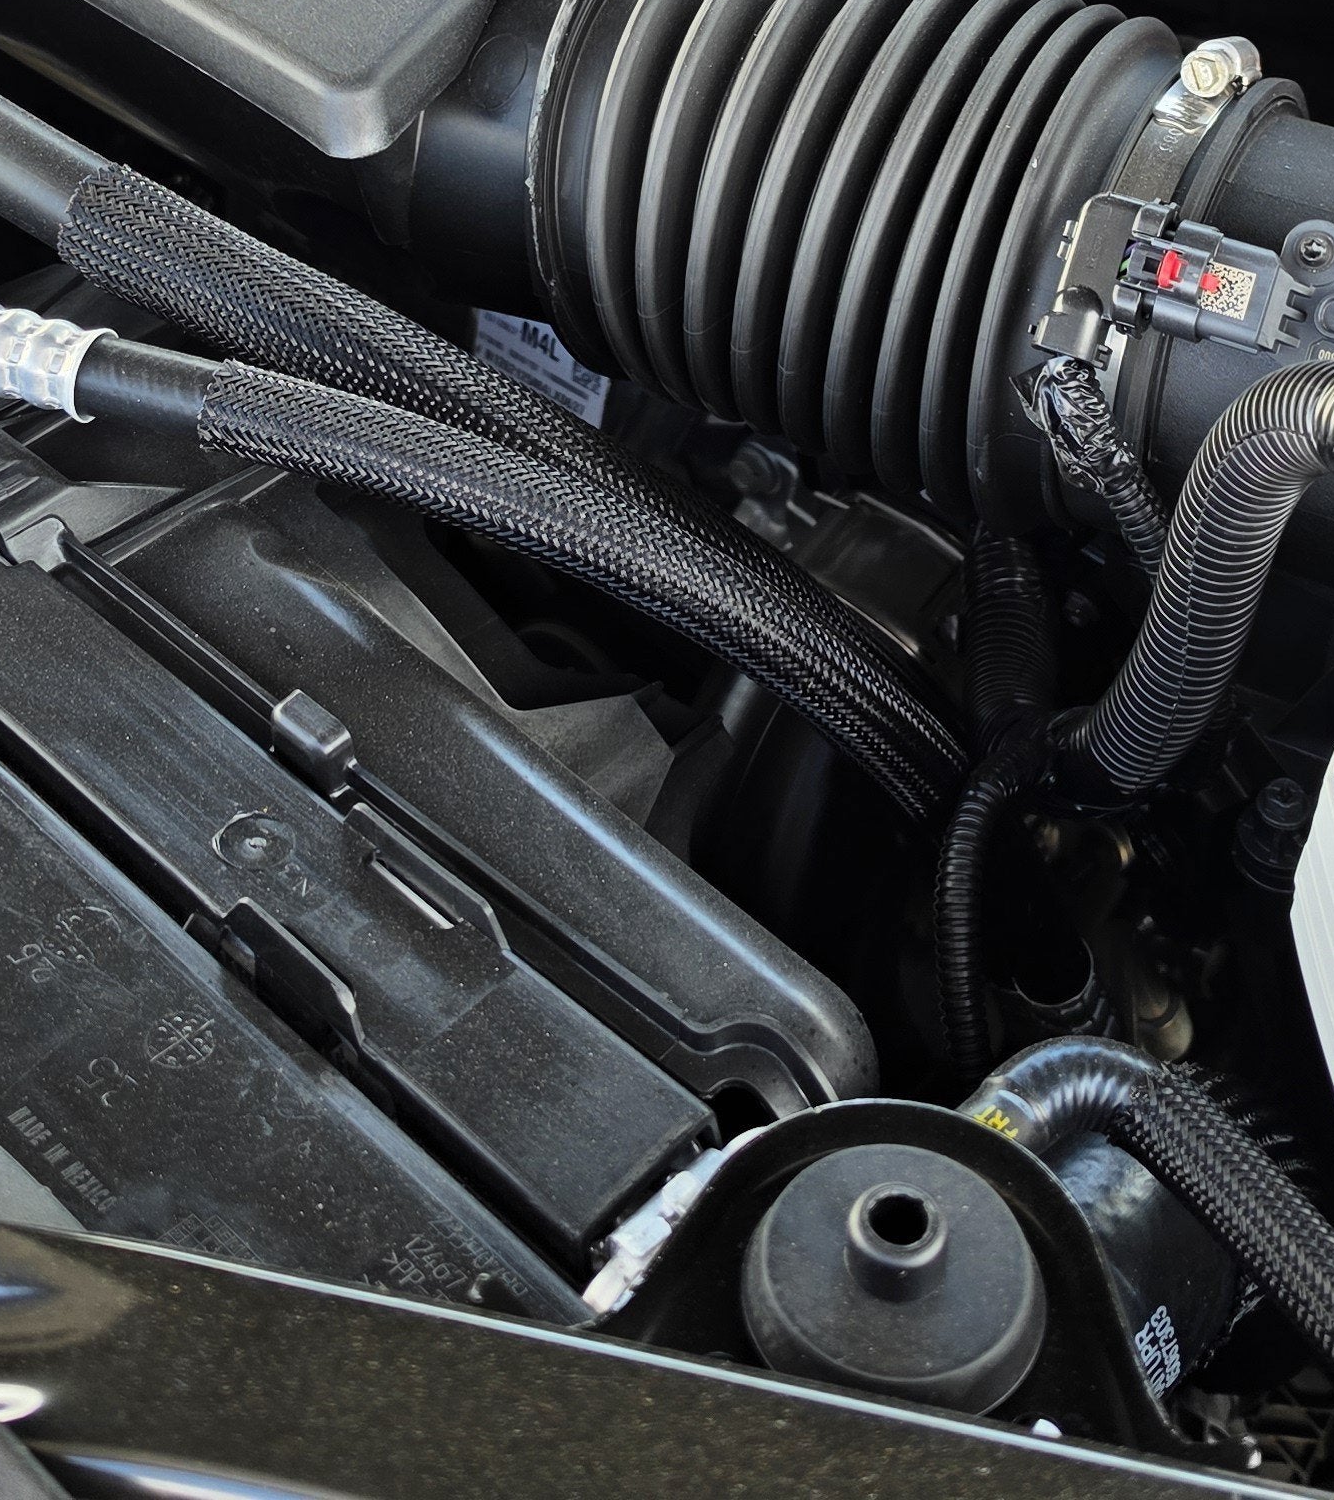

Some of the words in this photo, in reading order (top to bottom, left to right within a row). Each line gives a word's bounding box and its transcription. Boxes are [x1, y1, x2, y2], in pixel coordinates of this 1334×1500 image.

[520, 321, 560, 362] M4L
[7, 1105, 52, 1146] MADE
[44, 1141, 71, 1165] IN
[60, 1160, 118, 1212] MEXICO
